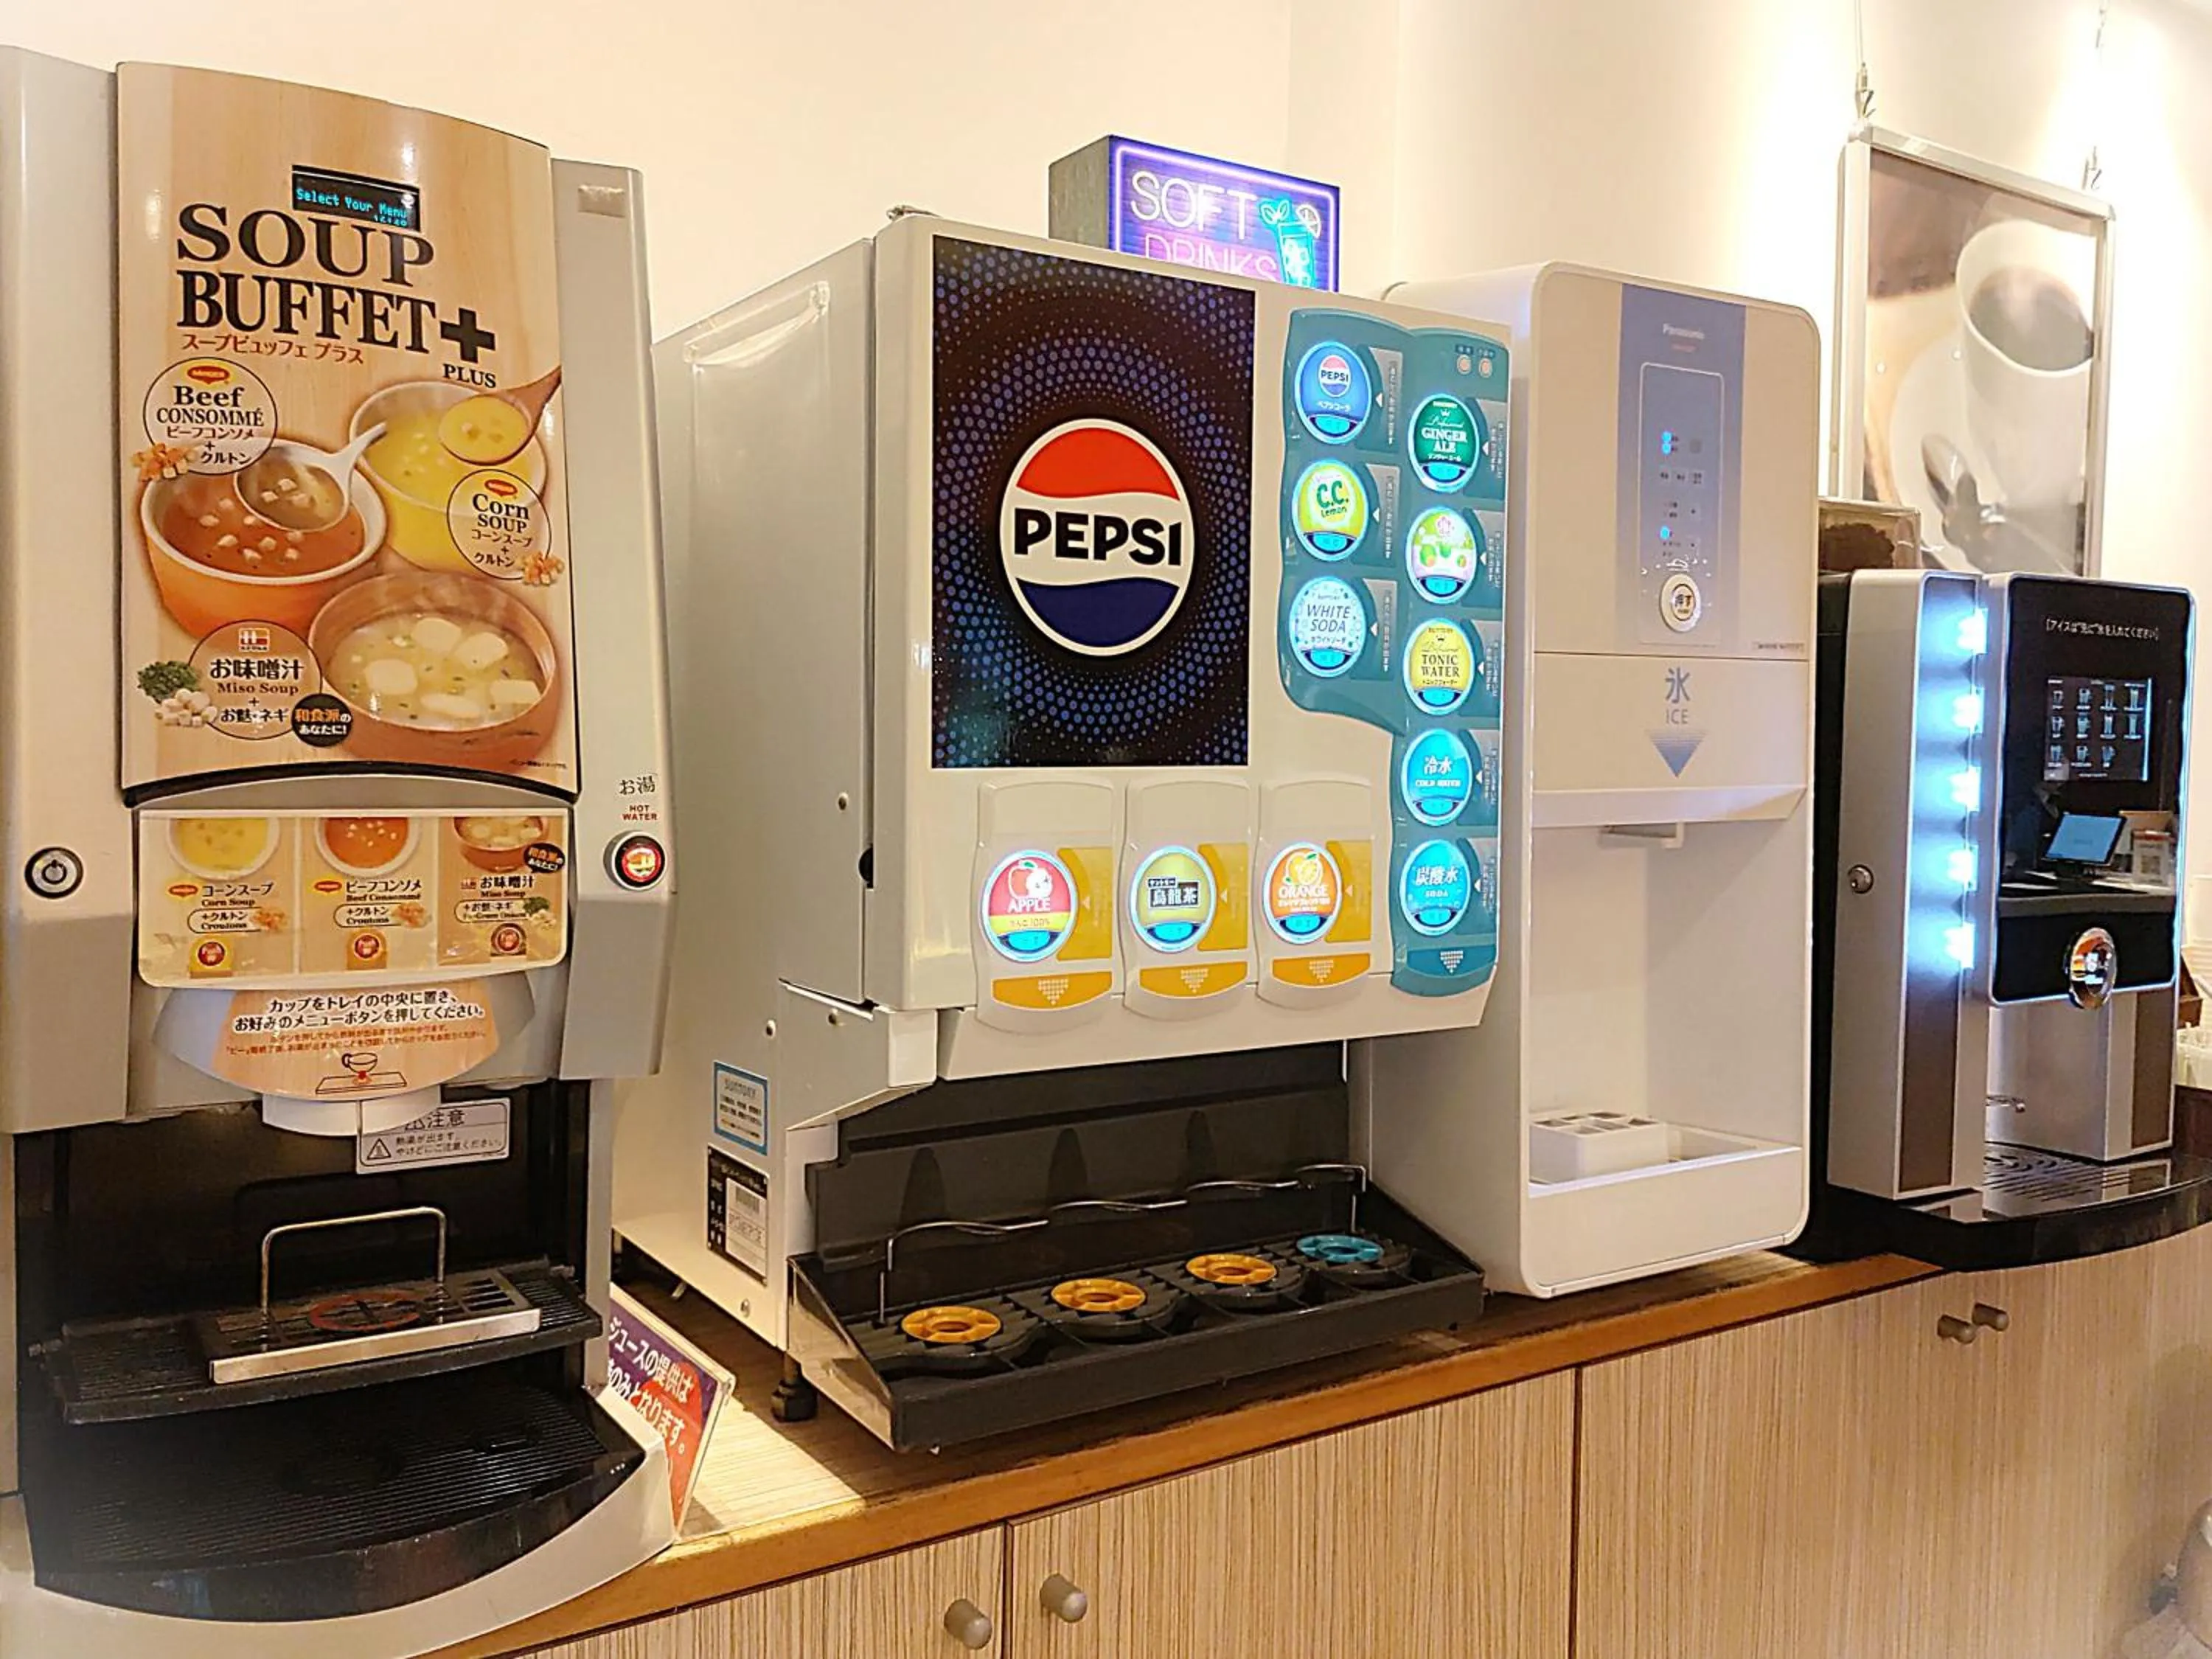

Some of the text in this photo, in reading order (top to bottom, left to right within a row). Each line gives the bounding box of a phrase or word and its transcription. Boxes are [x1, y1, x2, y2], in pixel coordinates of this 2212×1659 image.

[296, 188, 406, 218] Select Your Menu
[1130, 170, 1256, 240] SOFT
[177, 203, 434, 287] SOUP
[177, 269, 436, 355] BUFFET
[182, 334, 364, 364] スープビュッフェ プラス
[443, 363, 496, 388] PLUS
[1321, 369, 1349, 382] PEPSI
[173, 386, 245, 407] Beef
[156, 408, 264, 427] CONSOMMÉ
[167, 426, 254, 439] ビーフコンソメ
[1422, 428, 1467, 442] GINGER
[1433, 441, 1456, 453] ALE
[201, 451, 251, 465] クルトン
[472, 493, 529, 520] Corn
[1321, 506, 1347, 518] Lemon
[478, 514, 527, 533] SOUP
[472, 529, 532, 547] コーンスープ
[1015, 507, 1181, 566] PEPSI
[475, 552, 515, 568] クルトン
[1307, 604, 1352, 619] WHITE
[1310, 619, 1346, 633] SODA
[1422, 654, 1458, 665] TONIC
[210, 658, 304, 680] お味噌汁
[1421, 666, 1460, 677] WATER
[218, 683, 299, 696] Miso Soup
[1665, 667, 1691, 703] 氷
[1666, 709, 1689, 724] ICE
[1424, 755, 1453, 775] 冷水
[619, 775, 655, 795] お湯
[622, 813, 658, 821] WATER
[1416, 866, 1458, 886] 炭酸水
[202, 883, 274, 897] コーンスープ
[346, 879, 422, 893] ビーフコンソメ
[1279, 885, 1329, 898] ORANGE
[229, 898, 255, 907] Soup
[1008, 898, 1051, 912] APPLE
[427, 1109, 465, 1129] 注意
[608, 1316, 695, 1404] ジュースの提供は
